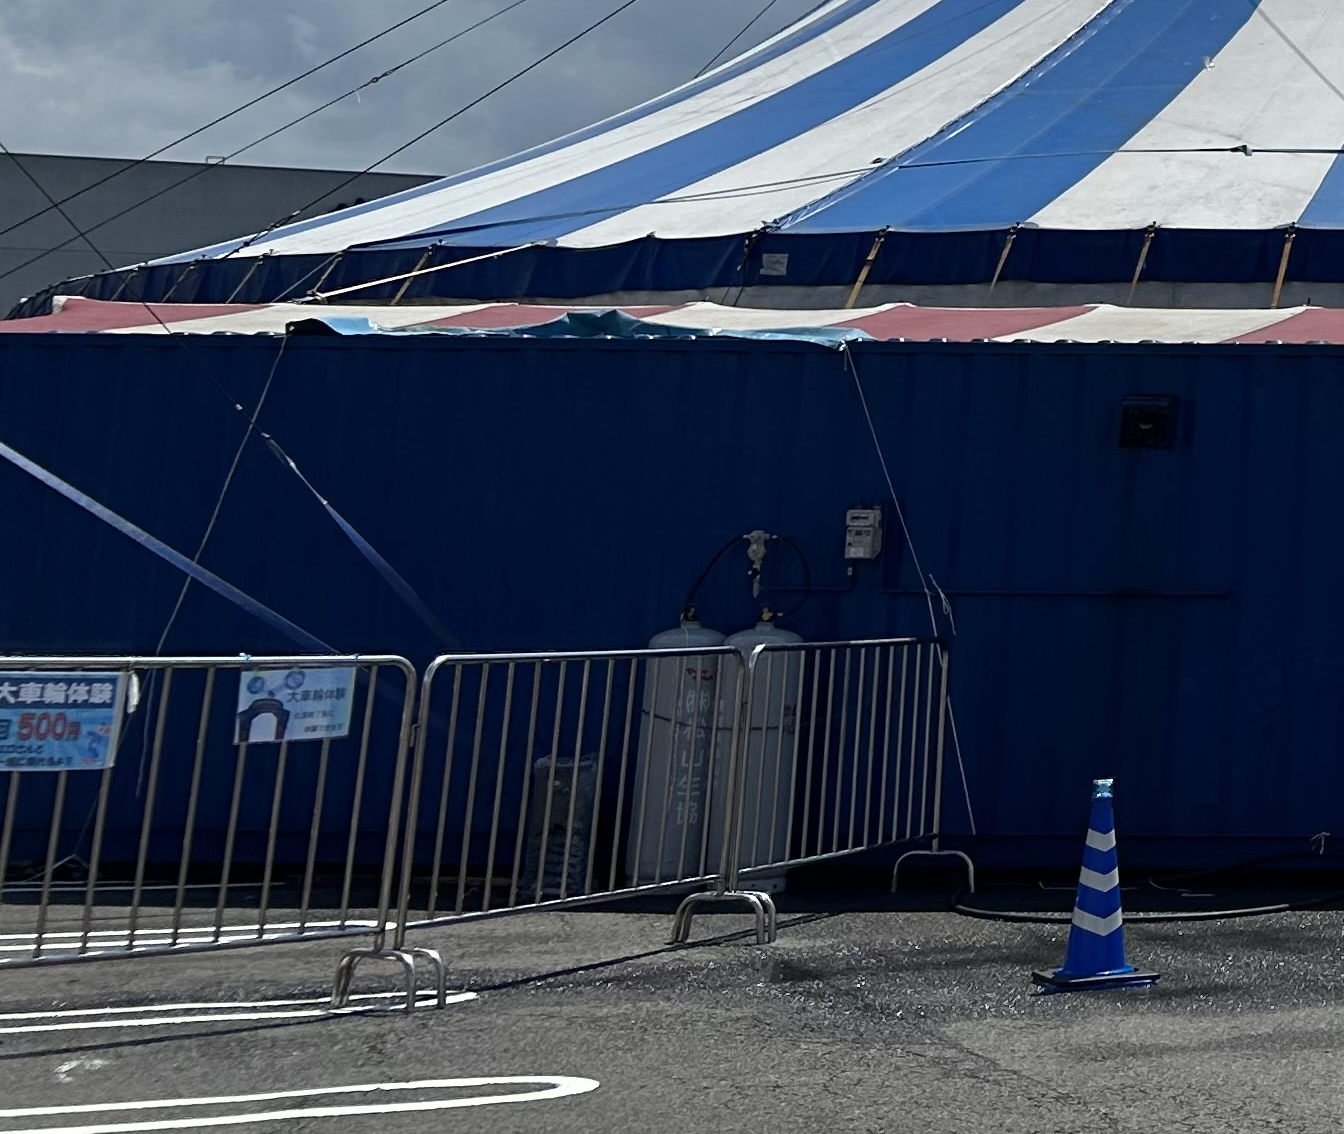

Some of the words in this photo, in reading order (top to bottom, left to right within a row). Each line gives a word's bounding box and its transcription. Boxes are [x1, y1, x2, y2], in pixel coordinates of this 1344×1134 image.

[0, 682, 113, 704] 大車輪体験
